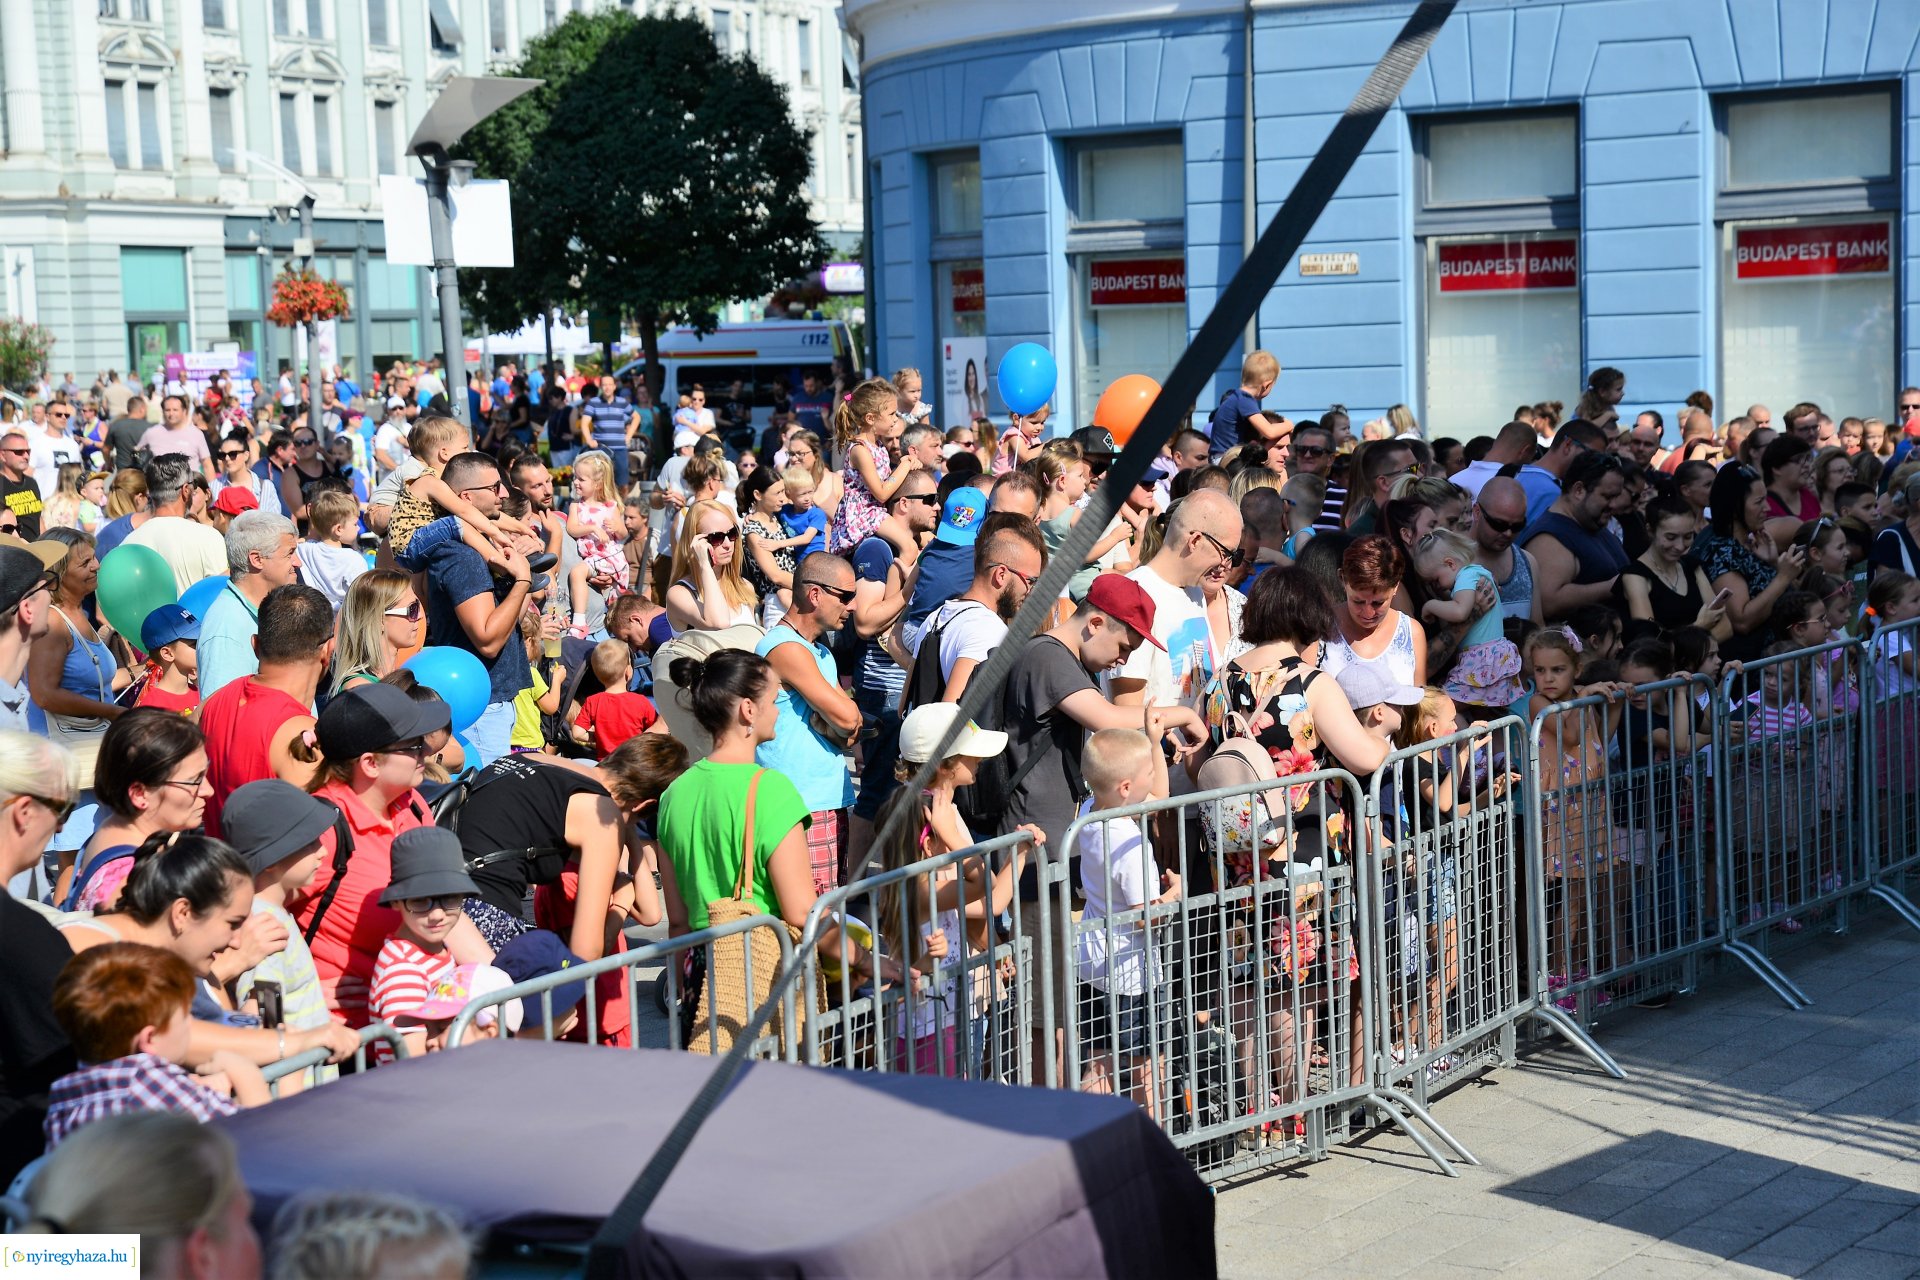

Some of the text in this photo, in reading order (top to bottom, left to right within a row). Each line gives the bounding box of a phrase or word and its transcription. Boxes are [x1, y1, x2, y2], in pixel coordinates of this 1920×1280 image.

[1738, 240, 1888, 262] BUDAPEST BANK
[1440, 256, 1577, 276] BUDAPEST BANK
[1091, 274, 1185, 291] BUDAPEST BAN
[809, 333, 829, 344] 112
[5, 490, 37, 506] BORUSSIA
